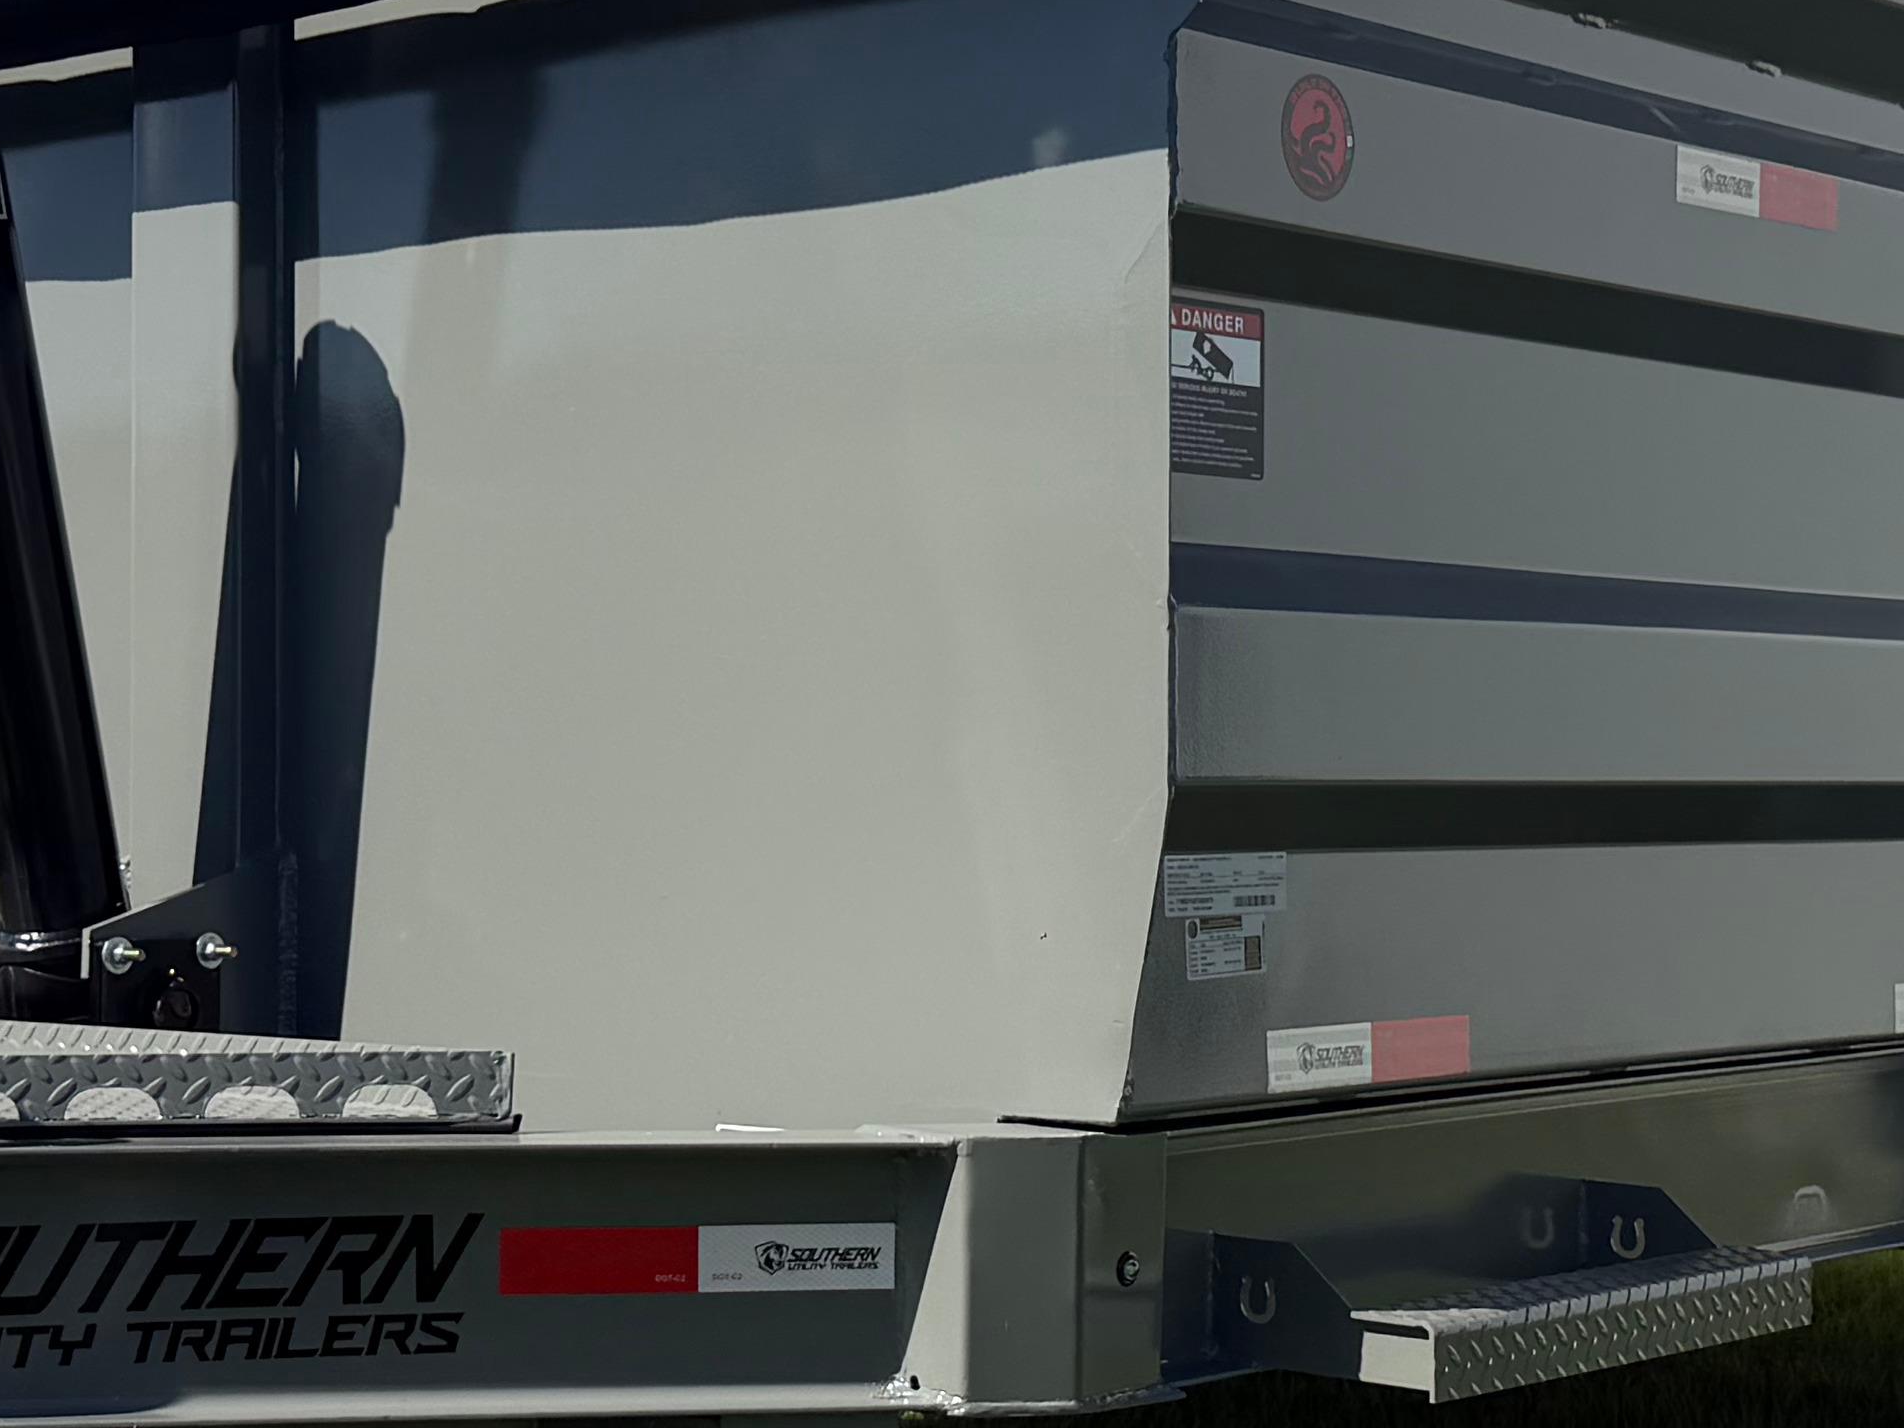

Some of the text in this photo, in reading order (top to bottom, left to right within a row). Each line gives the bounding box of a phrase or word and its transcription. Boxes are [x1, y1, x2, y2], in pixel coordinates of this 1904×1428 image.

[1181, 308, 1245, 334] DANGER
[787, 1245, 882, 1263] SOUTHERN
[787, 1260, 880, 1271] UTILITY TRAILERS
[126, 1312, 465, 1364] TRAILERS
